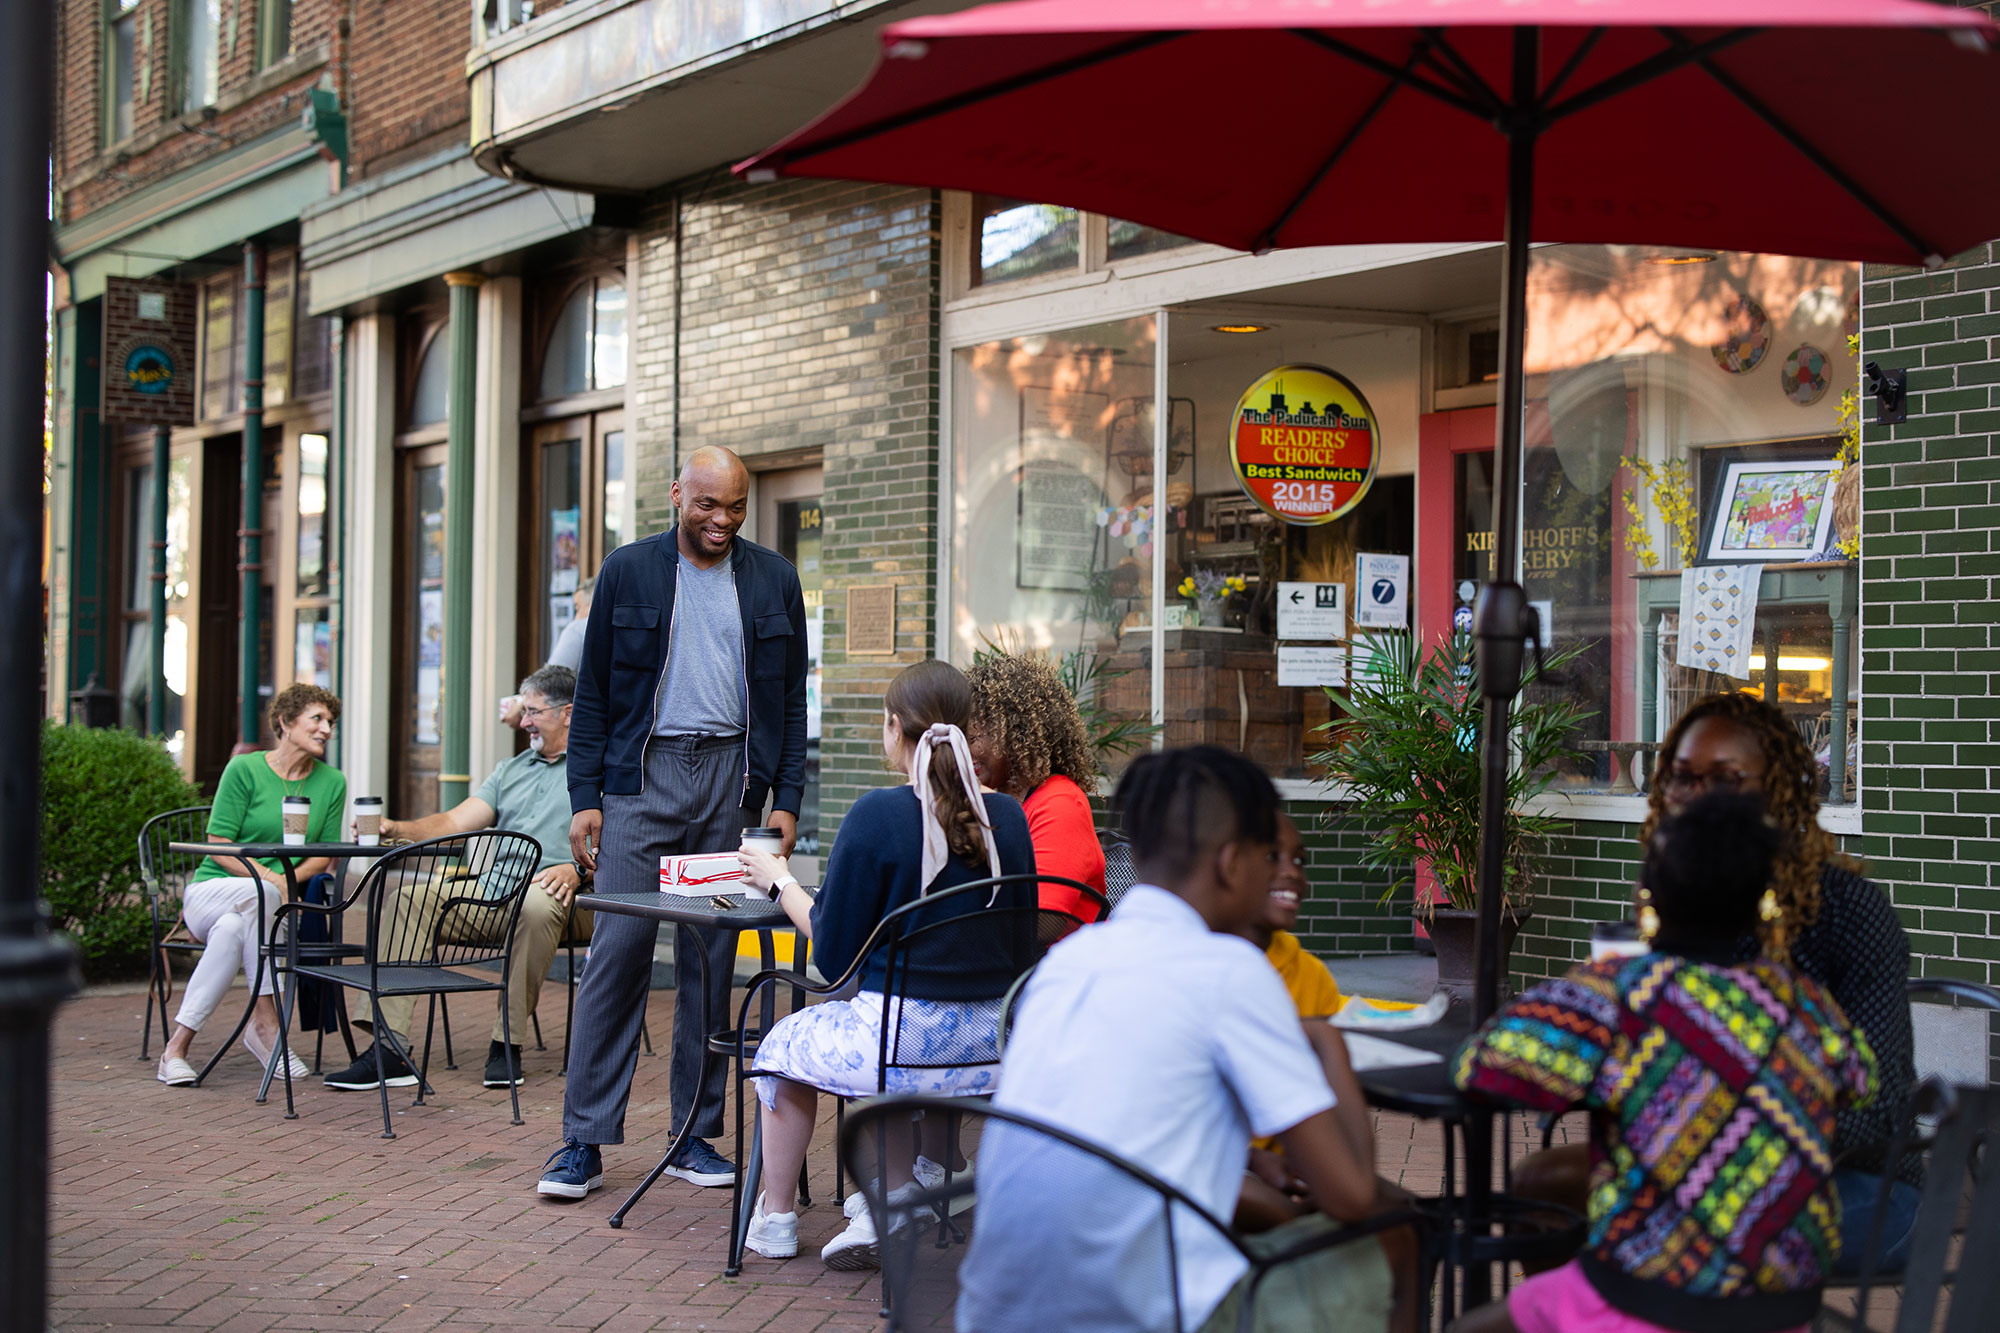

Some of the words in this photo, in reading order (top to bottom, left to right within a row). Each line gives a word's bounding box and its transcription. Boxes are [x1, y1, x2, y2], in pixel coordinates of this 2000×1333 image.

[1243, 409, 1271, 424] The
[1276, 410, 1336, 427] Paducah
[1341, 412, 1368, 428] Sun
[1260, 428, 1349, 449] READERS'
[1273, 446, 1335, 465] CHOICE
[1247, 464, 1282, 479] Best
[1285, 466, 1362, 482] Sandwich
[1272, 482, 1335, 501] 2015
[1273, 500, 1334, 513] WINNER
[800, 508, 821, 529] 114
[1377, 581, 1391, 602] 7
